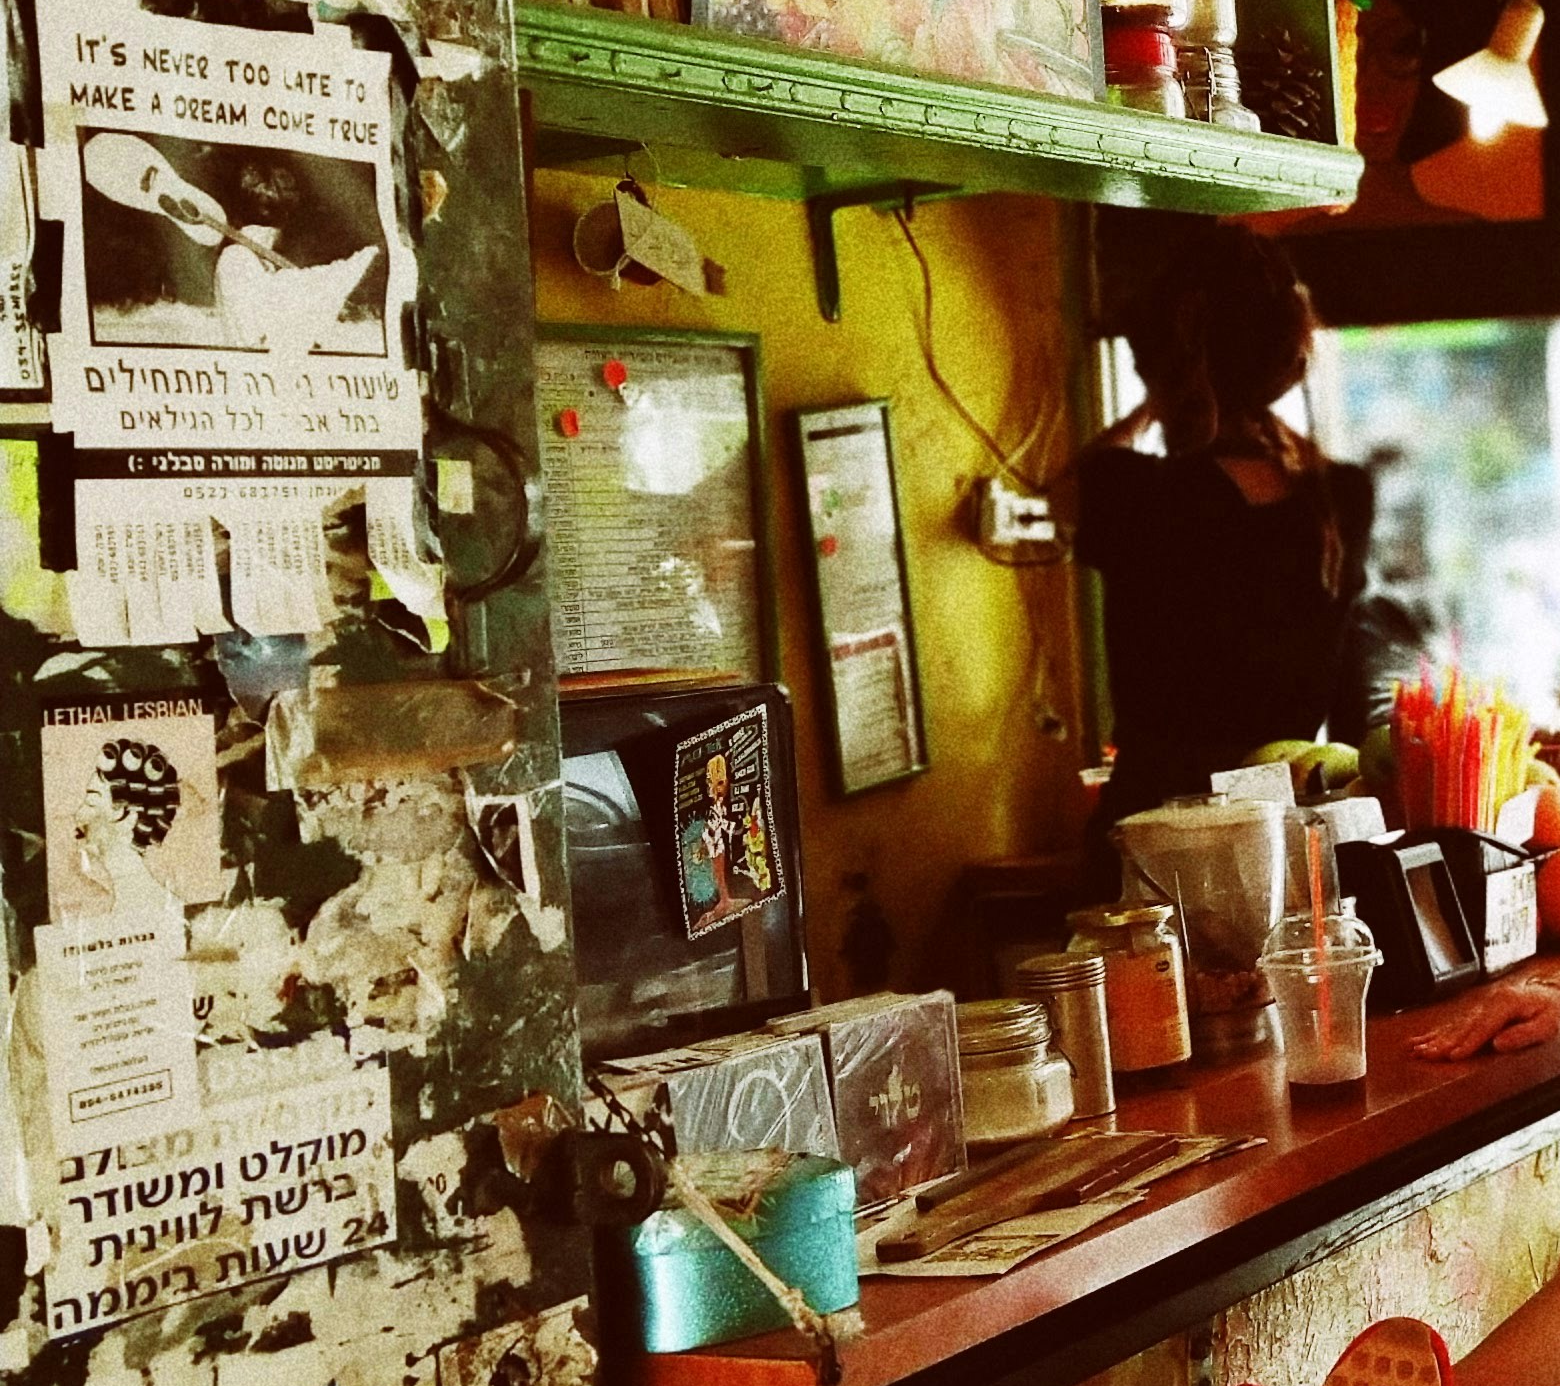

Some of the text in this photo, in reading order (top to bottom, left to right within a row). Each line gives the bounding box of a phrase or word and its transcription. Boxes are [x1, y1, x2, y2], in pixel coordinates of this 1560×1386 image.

[76, 33, 366, 104] IT'S NEVER TOO LATE TO
[70, 82, 379, 145] MAKE A DREAM COME TRUE
[84, 359, 228, 396] למתחילים
[328, 372, 399, 400] שיעורי
[120, 404, 215, 431] הגילאים
[225, 405, 264, 432] לכל
[338, 409, 381, 434] בתל
[152, 451, 205, 471] סבלני
[211, 455, 255, 471] ומורה
[262, 455, 308, 471] מנוסה
[44, 699, 202, 727] LETHAL LESBIAN
[69, 1128, 367, 1223] מוקלט ומשודר
[89, 1173, 356, 1266] ברשת לווינית
[53, 1211, 389, 1329] 24 שעות ביממה
